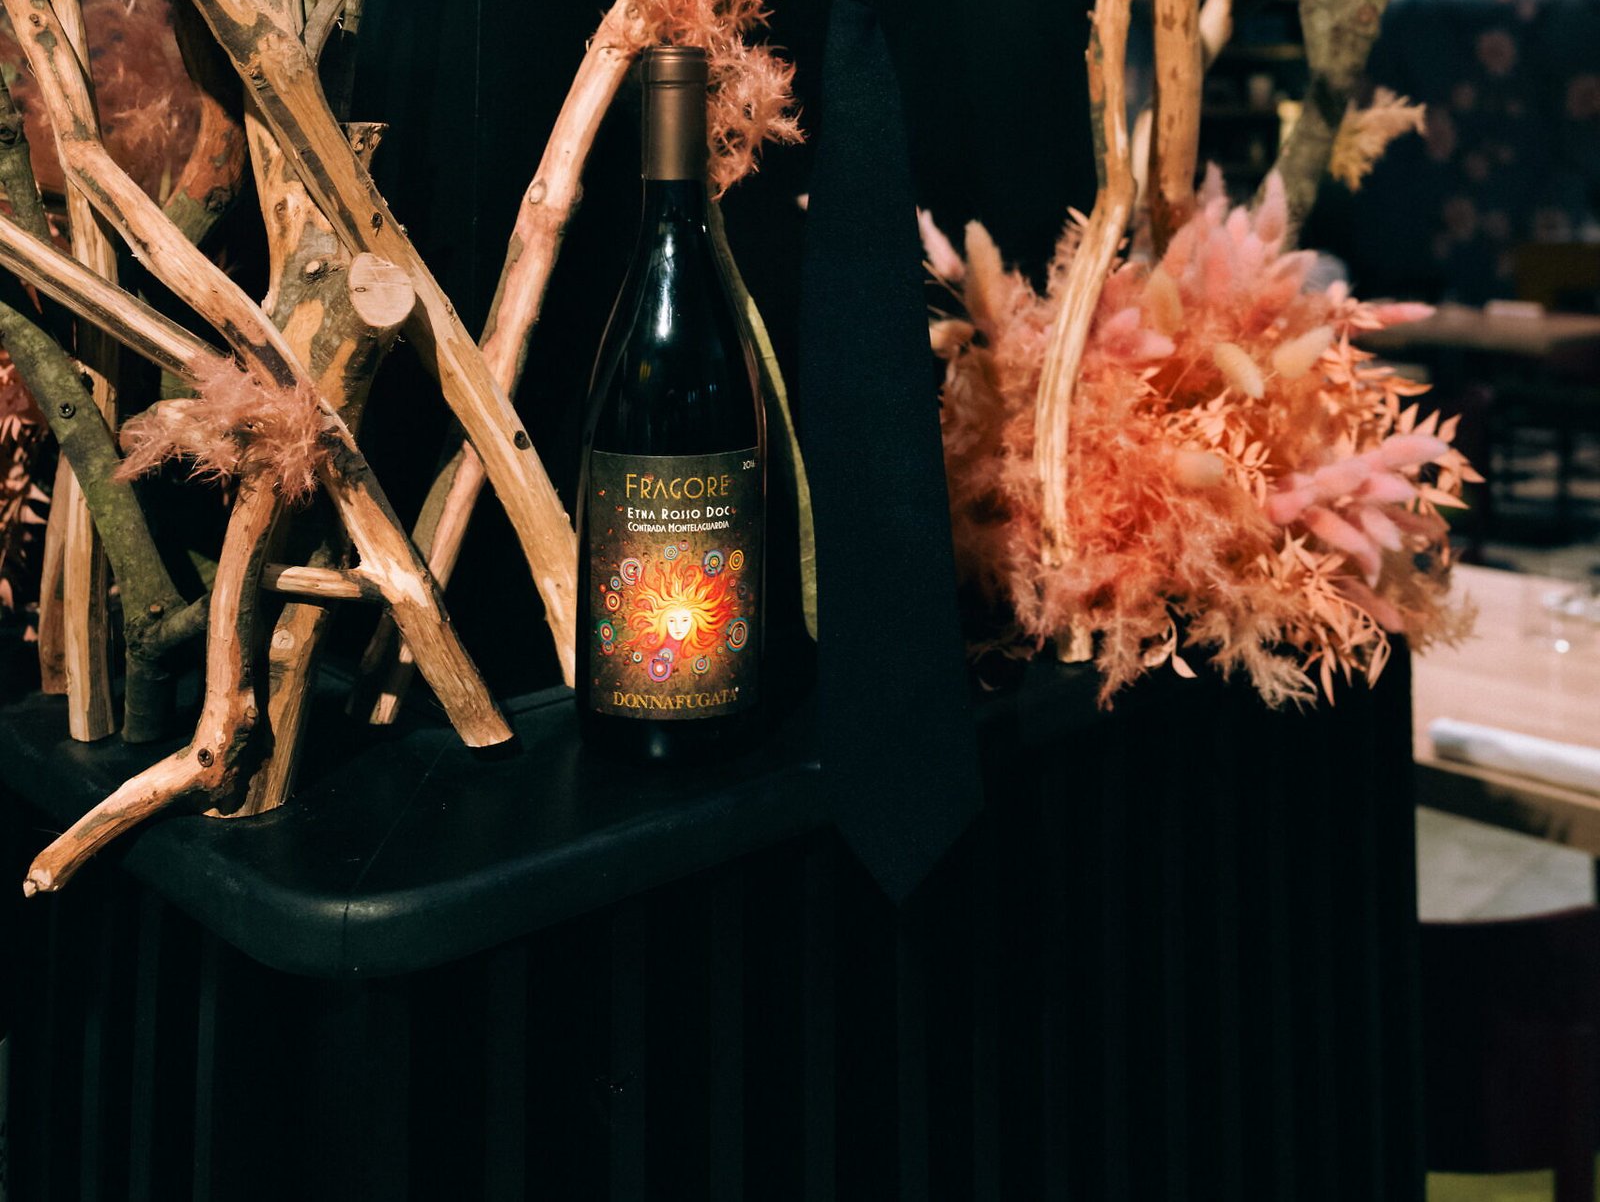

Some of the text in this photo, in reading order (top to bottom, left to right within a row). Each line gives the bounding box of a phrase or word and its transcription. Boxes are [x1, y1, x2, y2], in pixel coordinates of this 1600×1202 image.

[626, 473, 729, 499] FRAGORE
[627, 505, 730, 520] ETNA ROSSO DOC
[627, 520, 730, 533] CONTRADA MONTELAGUARDIA
[613, 688, 737, 710] DONNAFUGATA
